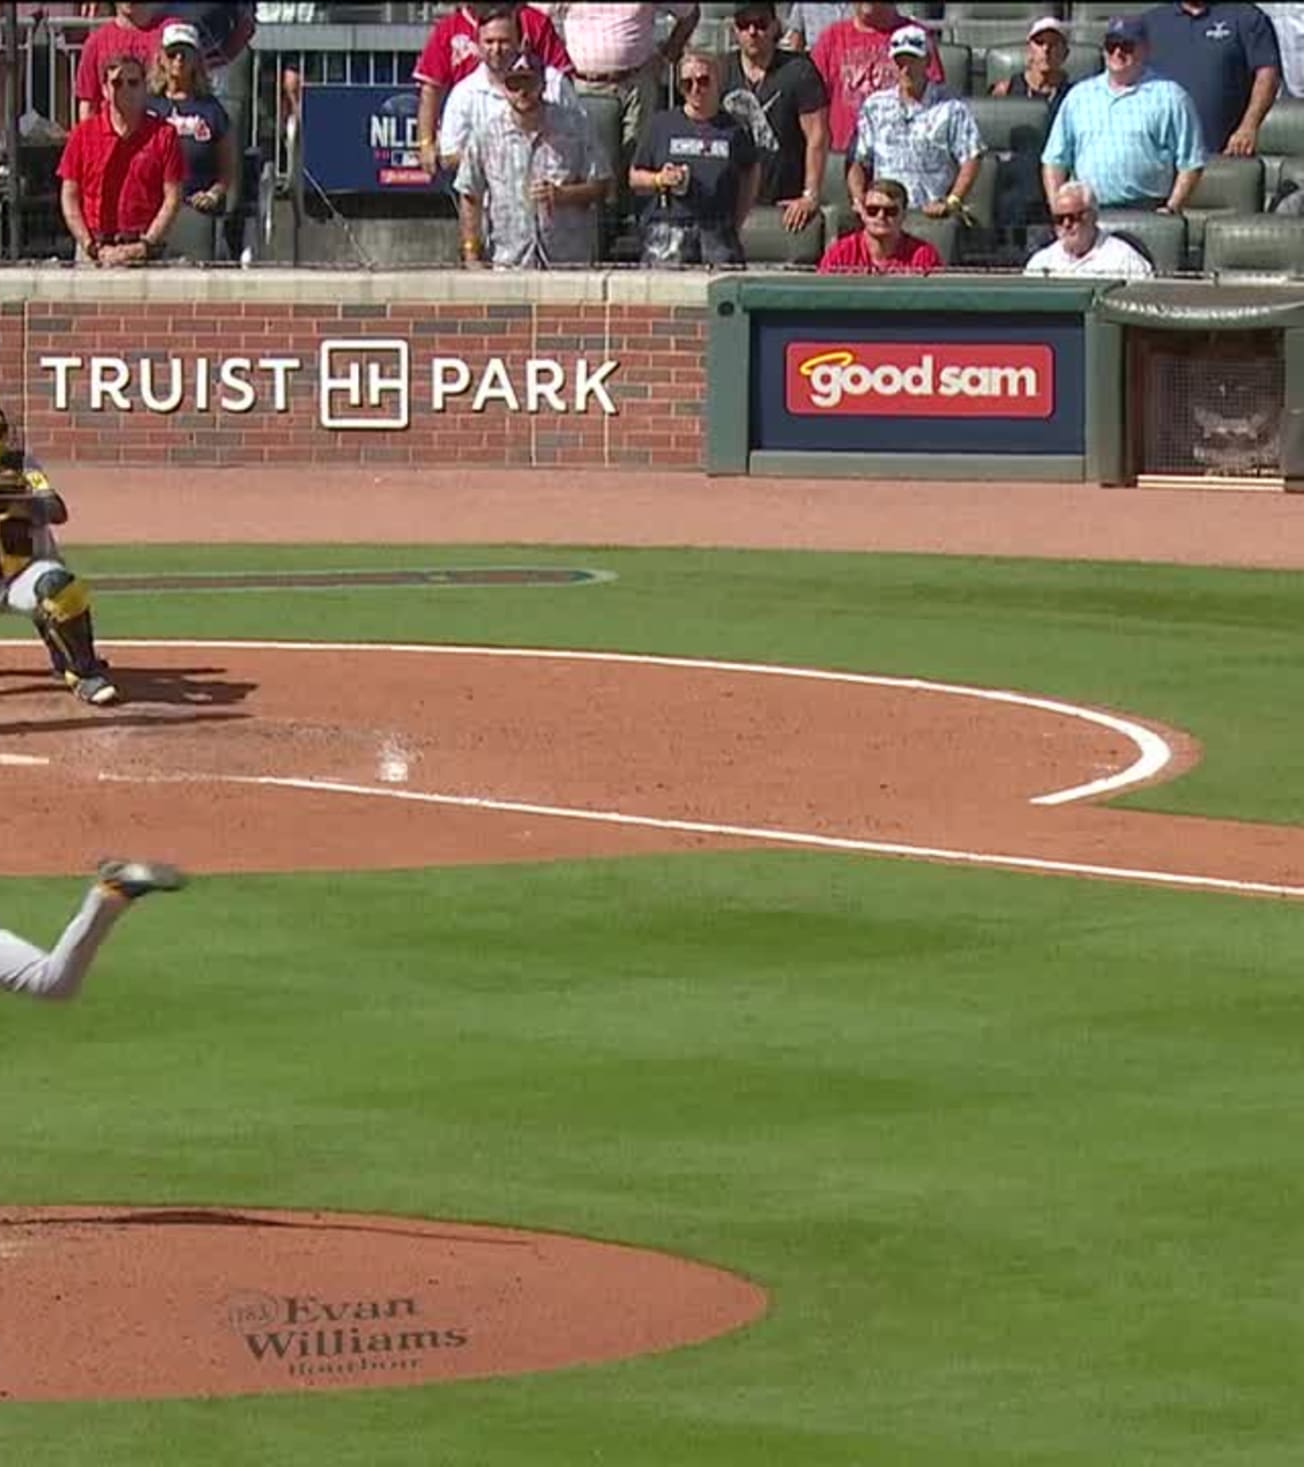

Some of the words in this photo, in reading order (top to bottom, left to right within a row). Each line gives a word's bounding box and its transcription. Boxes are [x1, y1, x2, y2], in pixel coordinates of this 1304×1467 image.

[40, 357, 300, 413] TRUIST
[432, 357, 620, 414] PARK
[810, 355, 934, 408] good
[938, 365, 1038, 397] sam
[282, 1295, 420, 1324] Evan
[245, 1327, 469, 1362] Williams
